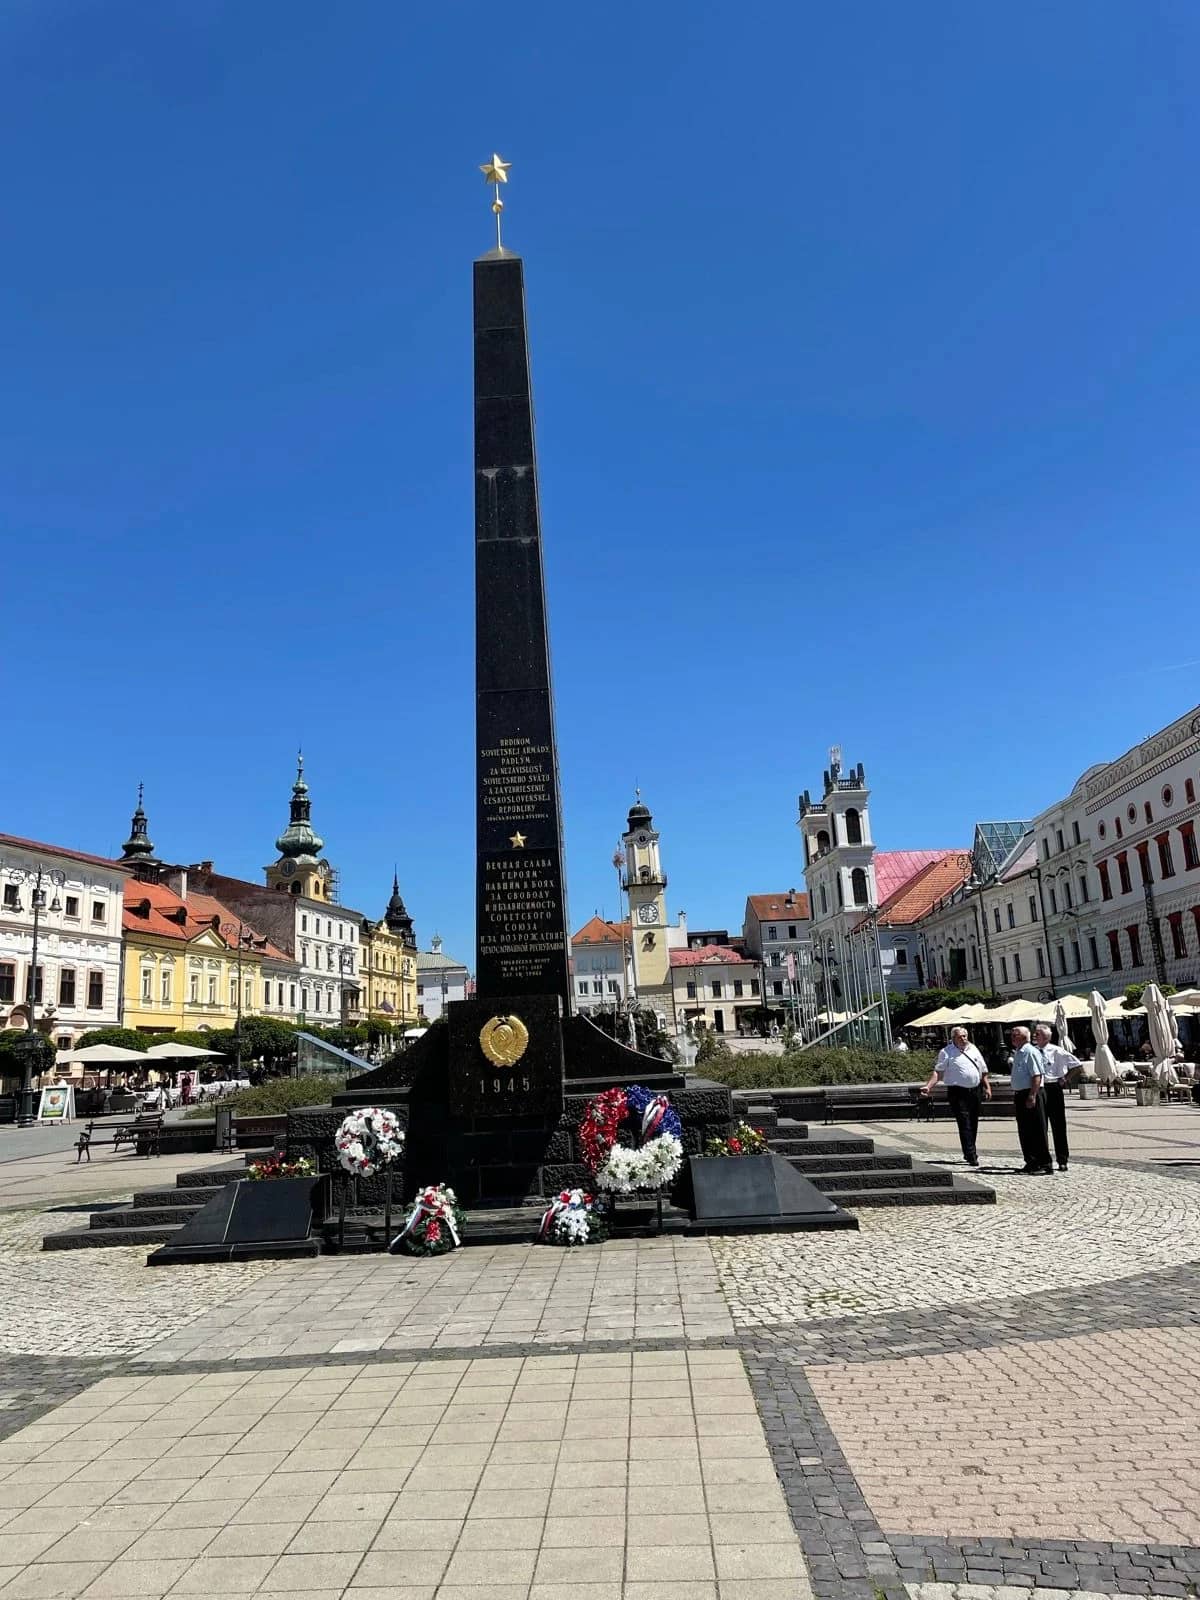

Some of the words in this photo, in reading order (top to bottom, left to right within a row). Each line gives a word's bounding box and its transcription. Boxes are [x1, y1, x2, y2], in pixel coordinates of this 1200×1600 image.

[500, 738, 531, 746] HRDINOM
[481, 747, 520, 757] SOVIETSKEJ
[483, 776, 526, 785] SOVIETSKEHO
[498, 805, 535, 813] REPUBLIKY
[486, 861, 520, 870] ВЕЧНАЯ
[524, 859, 552, 868] СЛАВА
[485, 881, 520, 891] ПАВШИМ
[532, 880, 554, 888] БОЯХ
[491, 892, 501, 901] ЗА
[507, 890, 550, 900] СВОБОДУ
[491, 911, 552, 922] СОВЕТСКОГО
[505, 922, 537, 932] СОЮЗА
[480, 1078, 530, 1094] 1945
